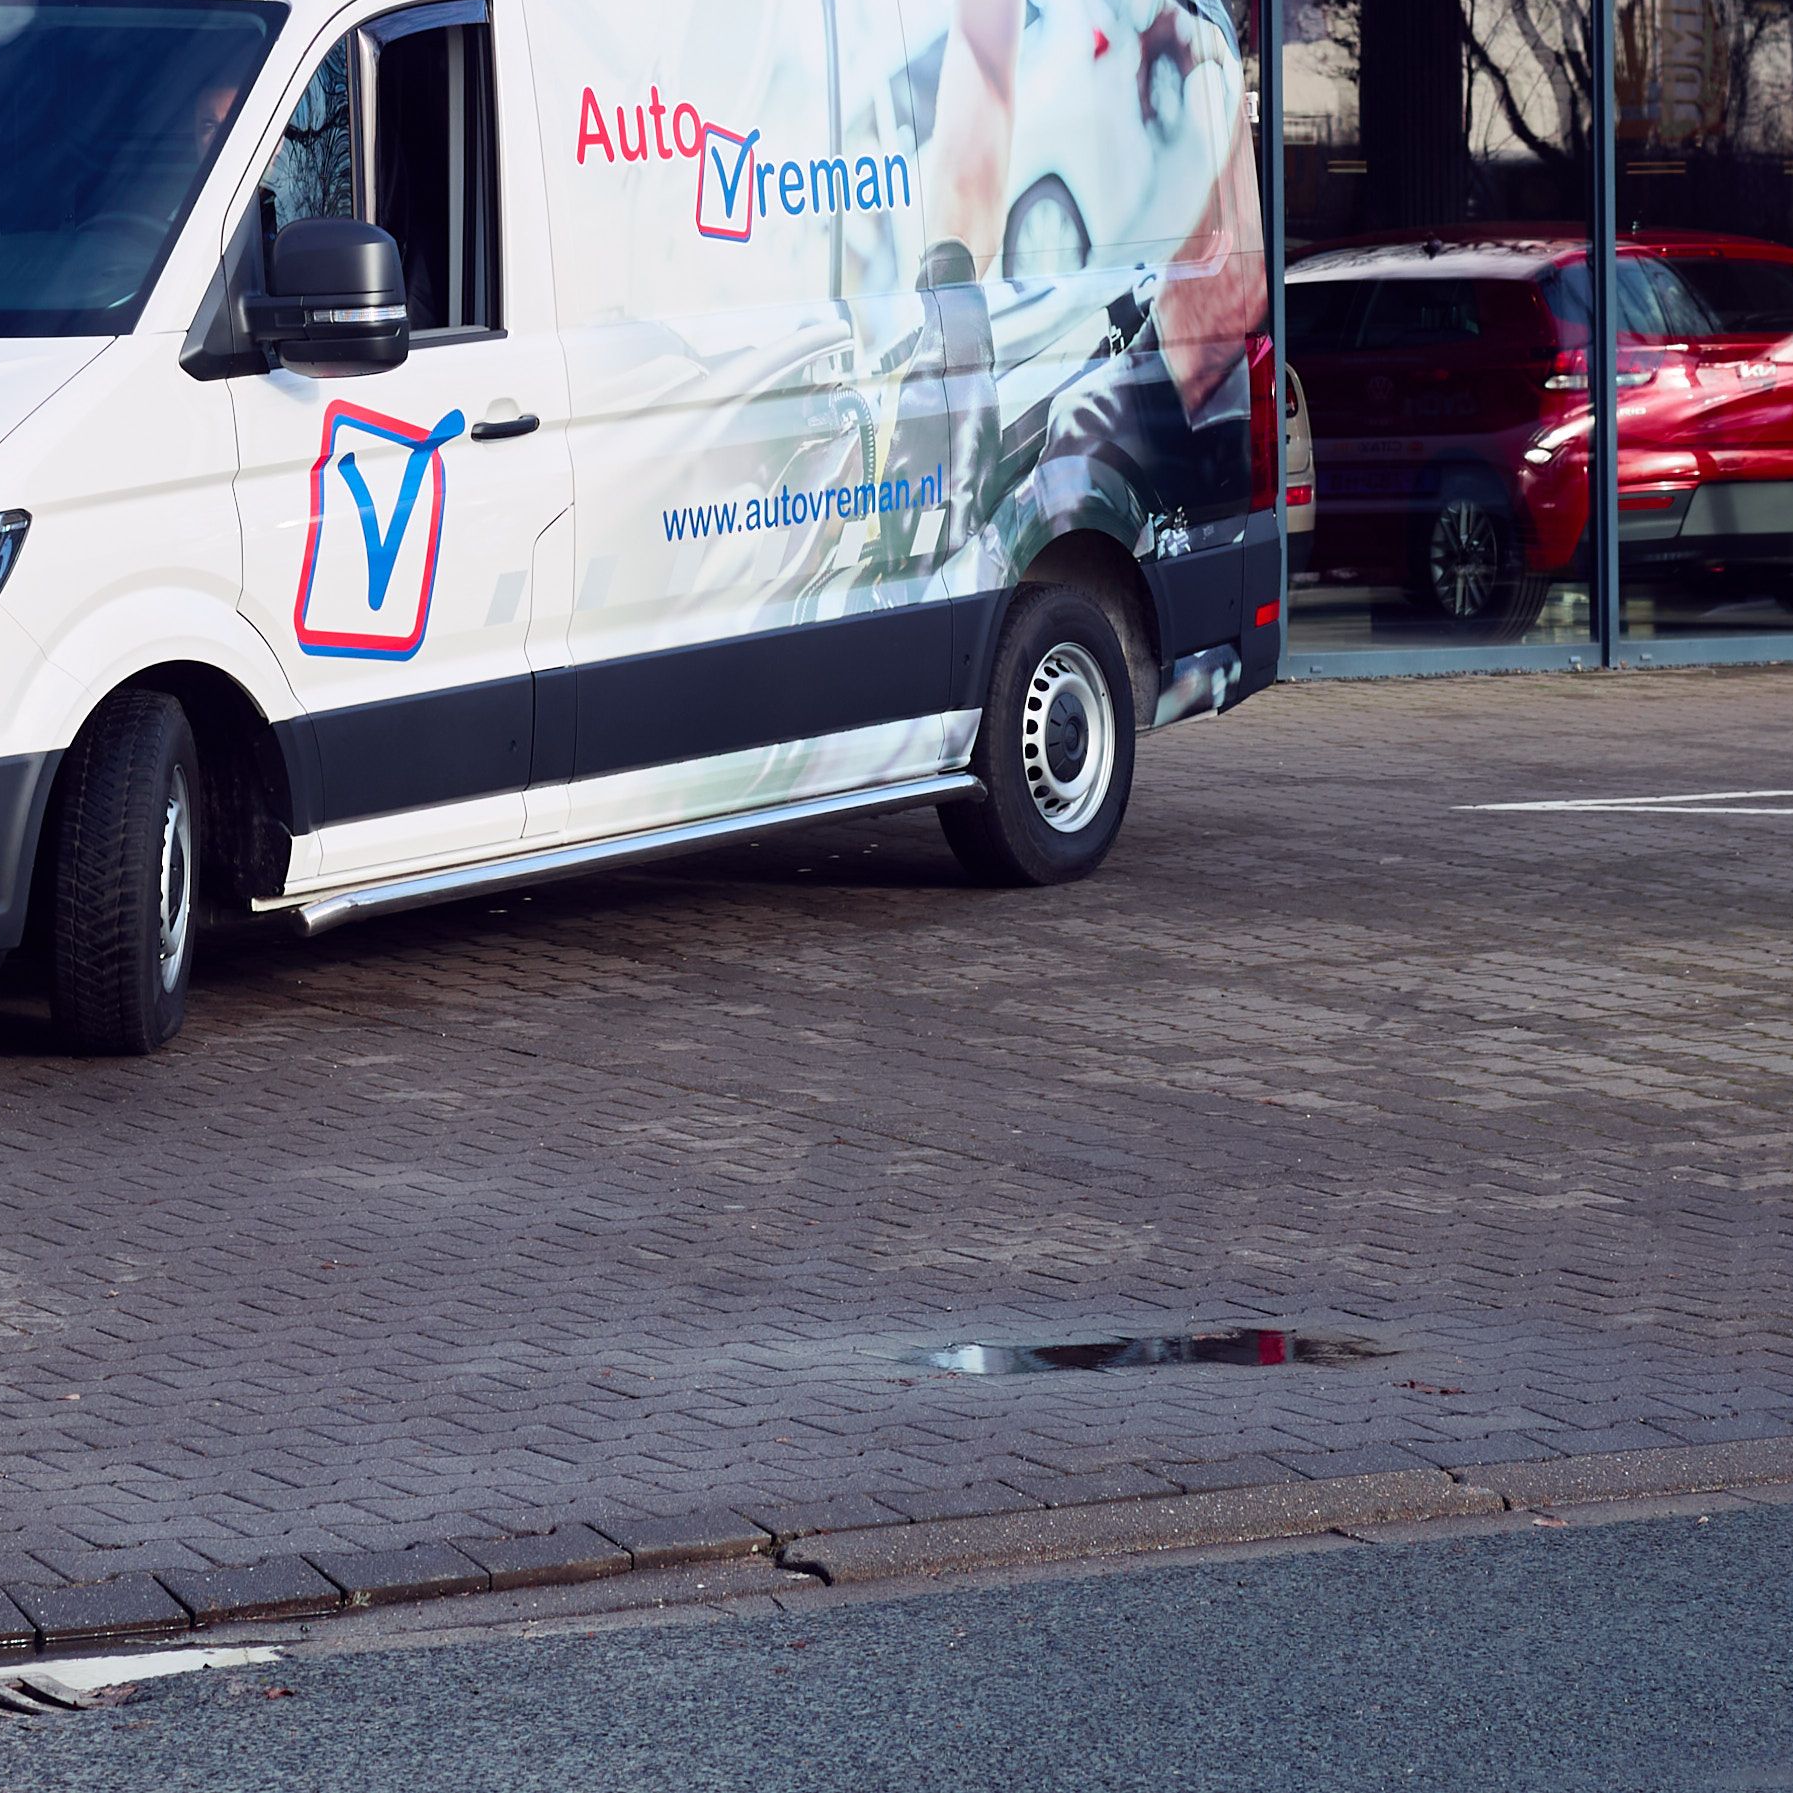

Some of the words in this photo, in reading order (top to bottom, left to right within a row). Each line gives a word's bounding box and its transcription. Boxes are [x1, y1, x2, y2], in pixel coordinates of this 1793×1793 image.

[576, 84, 702, 165] Auto
[710, 128, 911, 219] Vreman
[662, 462, 943, 543] www.autovreman.nl
